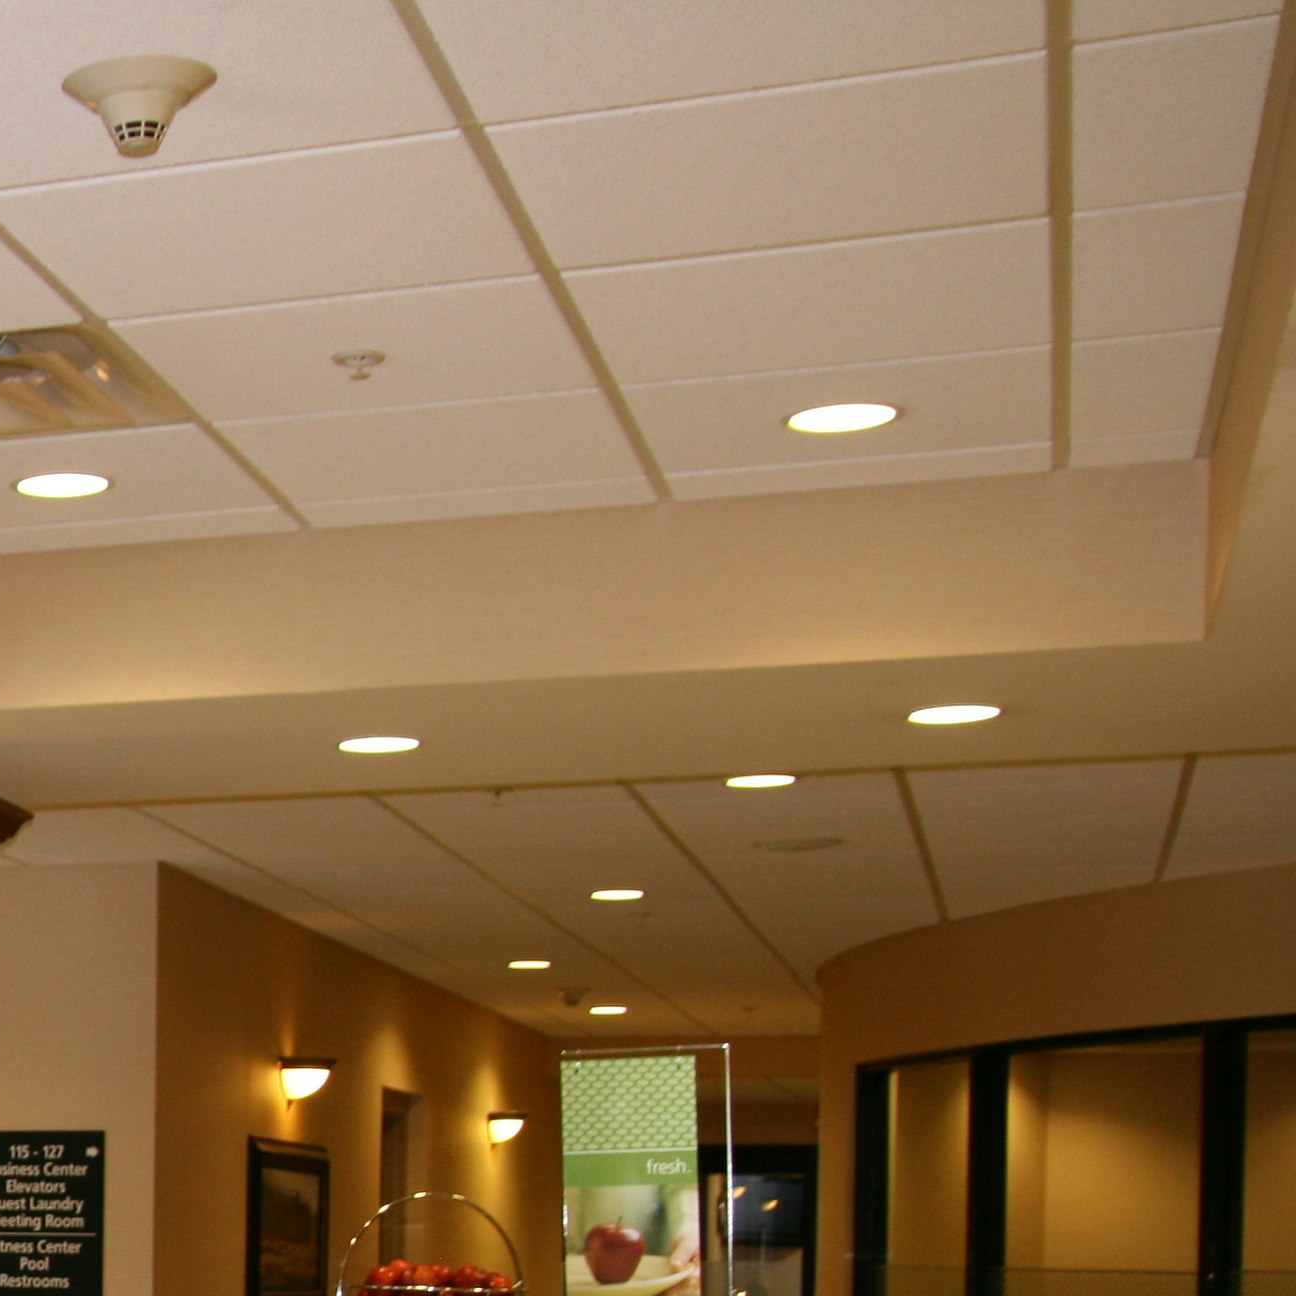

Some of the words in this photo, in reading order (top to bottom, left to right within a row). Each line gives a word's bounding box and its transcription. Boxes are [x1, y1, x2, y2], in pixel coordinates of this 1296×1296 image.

[9, 1145, 30, 1159] 115
[43, 1145, 65, 1159] 127
[43, 1162, 88, 1176] Center
[646, 1158, 692, 1175] fresh.
[5, 1179, 67, 1194] Elevators
[29, 1196, 84, 1214] Laundry
[45, 1214, 85, 1228] Room
[37, 1239, 82, 1254] Center
[19, 1256, 49, 1271] Pool
[0, 1273, 70, 1288] Restrooms
